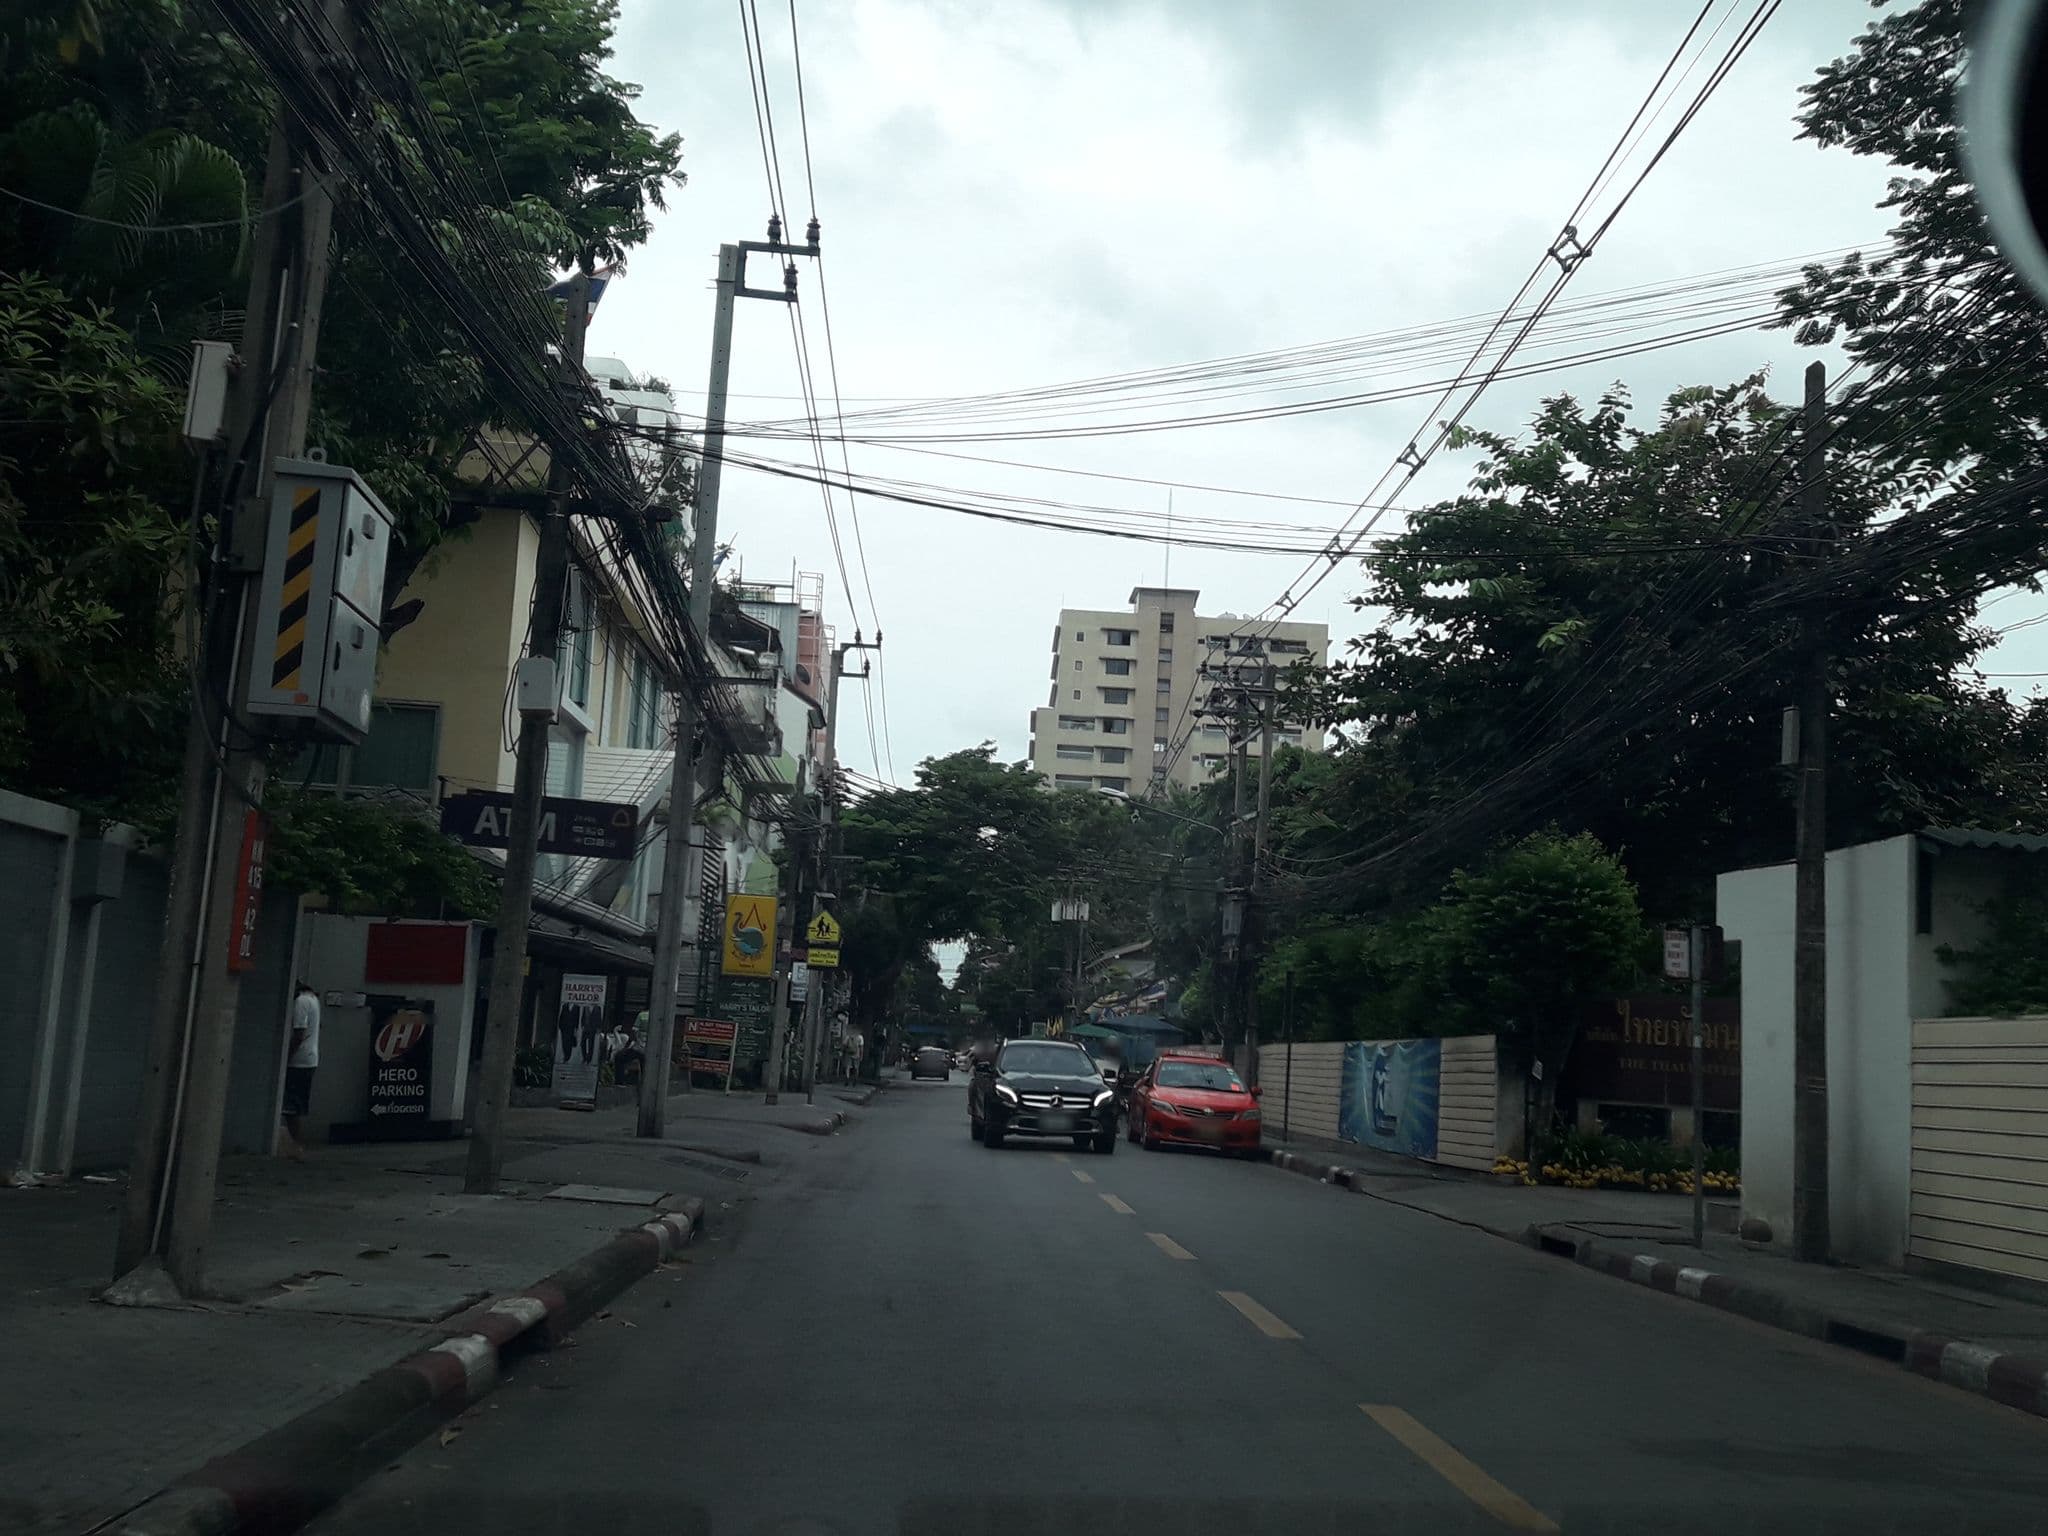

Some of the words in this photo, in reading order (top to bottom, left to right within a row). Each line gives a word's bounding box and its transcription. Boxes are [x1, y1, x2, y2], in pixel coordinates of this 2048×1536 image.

[565, 983, 604, 993] HARRY'S
[567, 993, 600, 1001] TAILOR
[378, 1068, 418, 1081] HERO
[371, 1084, 425, 1096] PARKING
